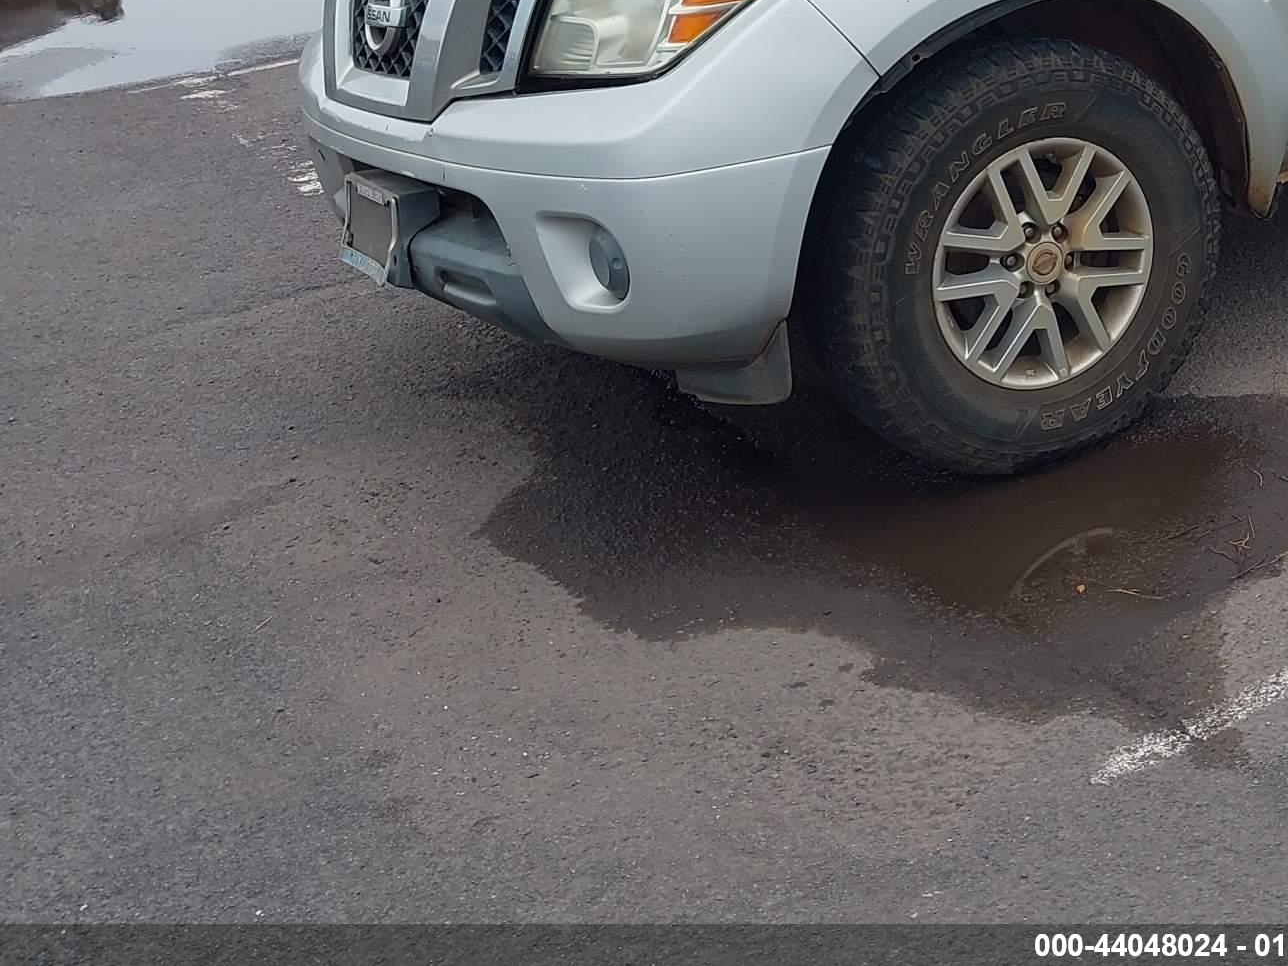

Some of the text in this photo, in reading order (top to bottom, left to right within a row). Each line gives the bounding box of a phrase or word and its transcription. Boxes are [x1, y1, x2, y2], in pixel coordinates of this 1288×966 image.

[367, 7, 391, 23] SSAN
[905, 101, 1067, 275] WRANGLER
[1040, 252, 1192, 431] GOODYEAR
